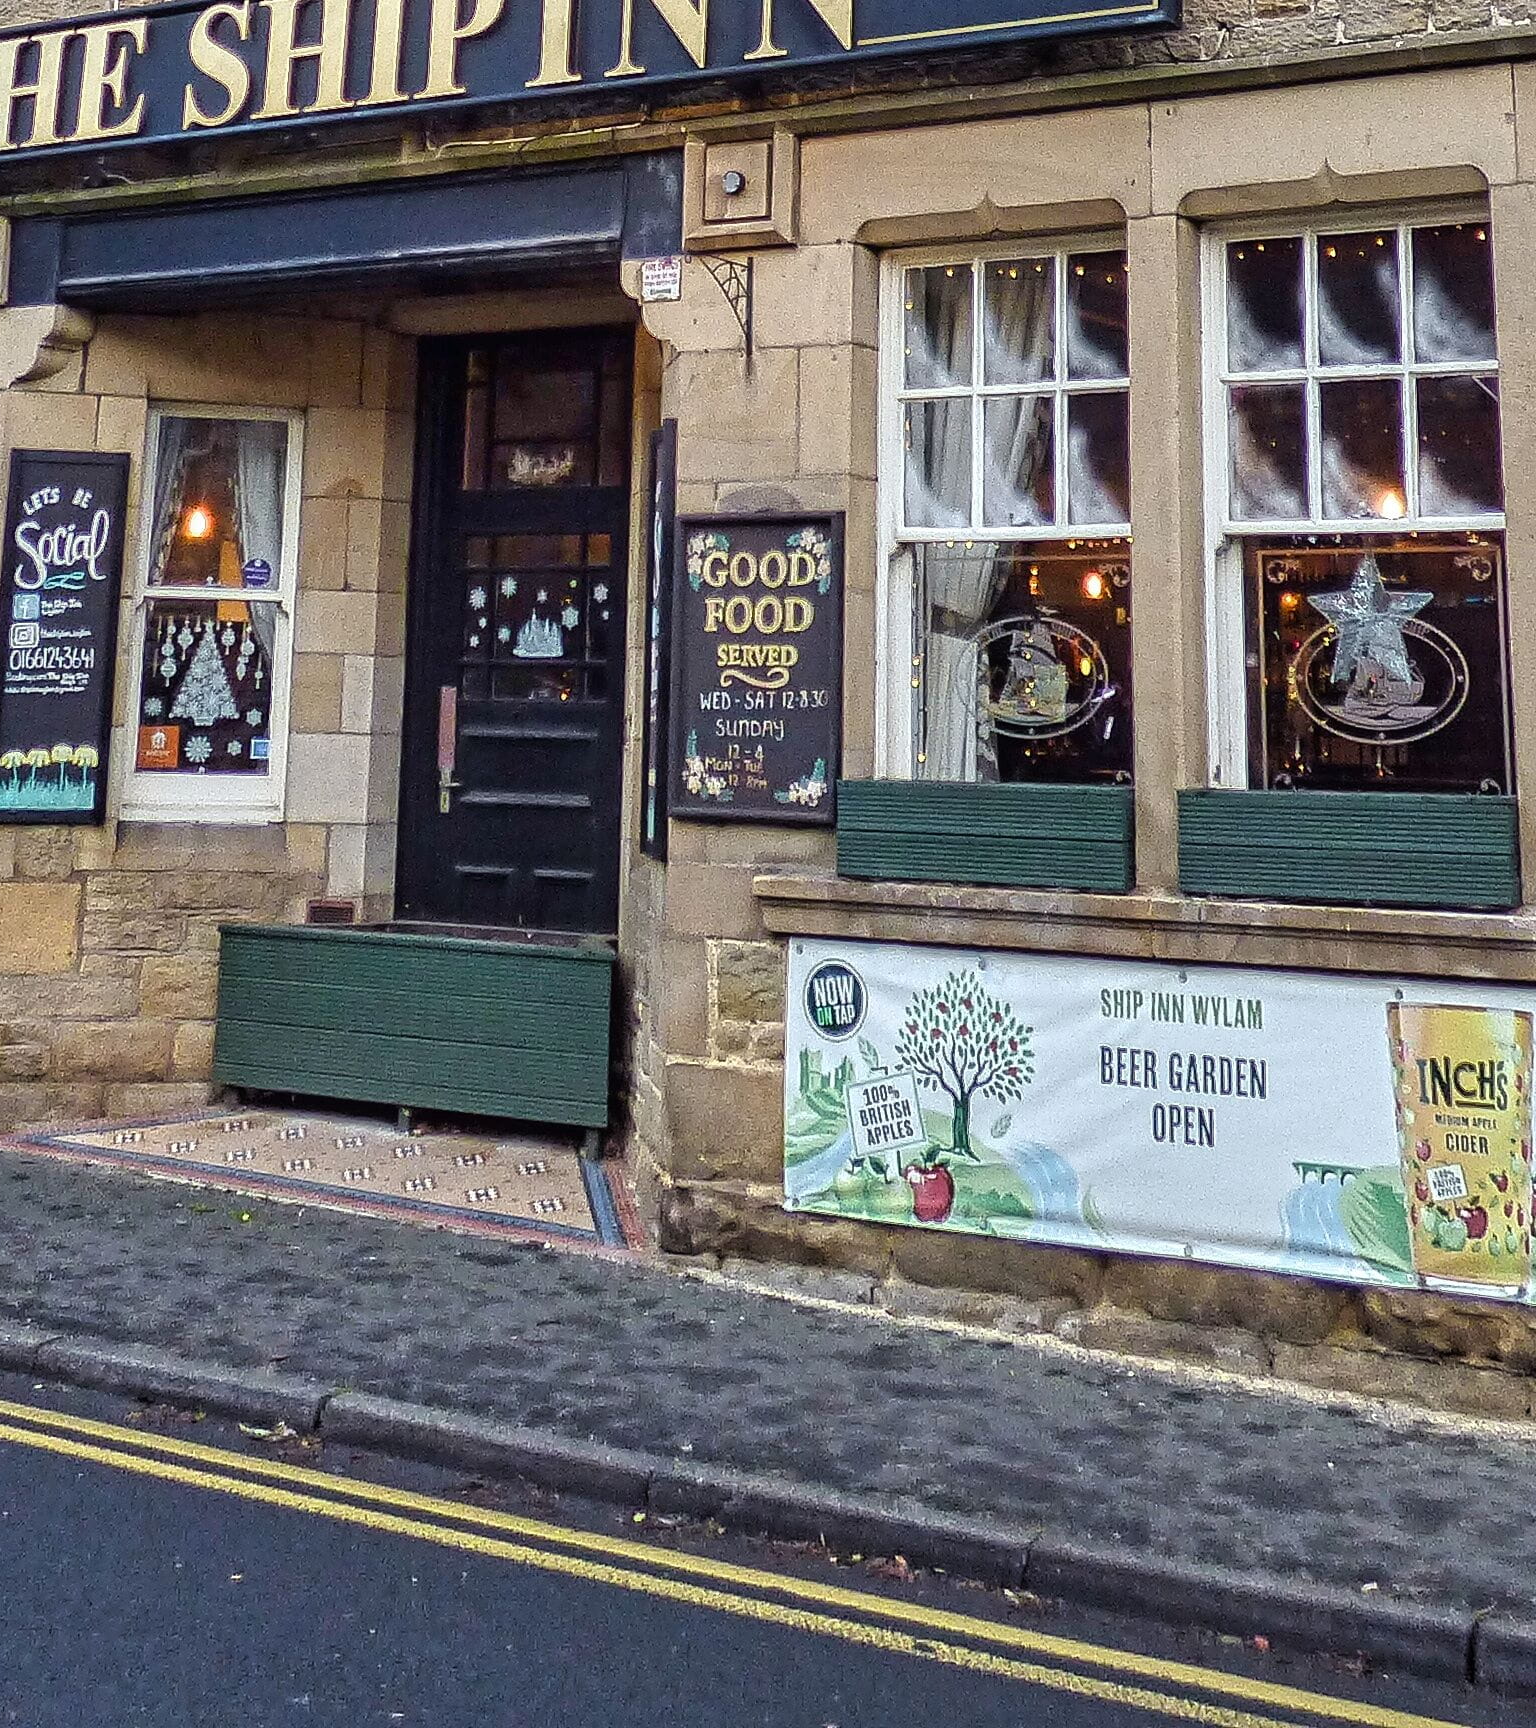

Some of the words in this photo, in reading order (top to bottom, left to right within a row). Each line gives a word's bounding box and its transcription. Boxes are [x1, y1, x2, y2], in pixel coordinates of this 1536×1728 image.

[71, 487, 94, 509] BE
[13, 508, 110, 590] Social
[702, 550, 817, 589] GOOD
[703, 594, 816, 635] FOOD
[716, 643, 800, 668] SERVED
[700, 691, 731, 711] WED
[744, 690, 777, 710] SAT
[715, 717, 785, 742] SUNDAY
[813, 974, 855, 1008] NOW
[816, 1006, 834, 1027] ON
[834, 1004, 856, 1026] TAP
[1100, 987, 1144, 1020] SHIP
[1150, 991, 1185, 1024] INN
[1191, 994, 1263, 1030] WYLAM
[1100, 1044, 1159, 1090] BEER
[1168, 1051, 1267, 1100] GARDEN
[1415, 1055, 1508, 1111] INCH'S
[863, 1084, 900, 1107] 100%
[858, 1098, 912, 1128] BRITISH
[1152, 1102, 1216, 1148] OPEN
[866, 1119, 914, 1147] APPLES
[1445, 1132, 1489, 1155] CIDER
